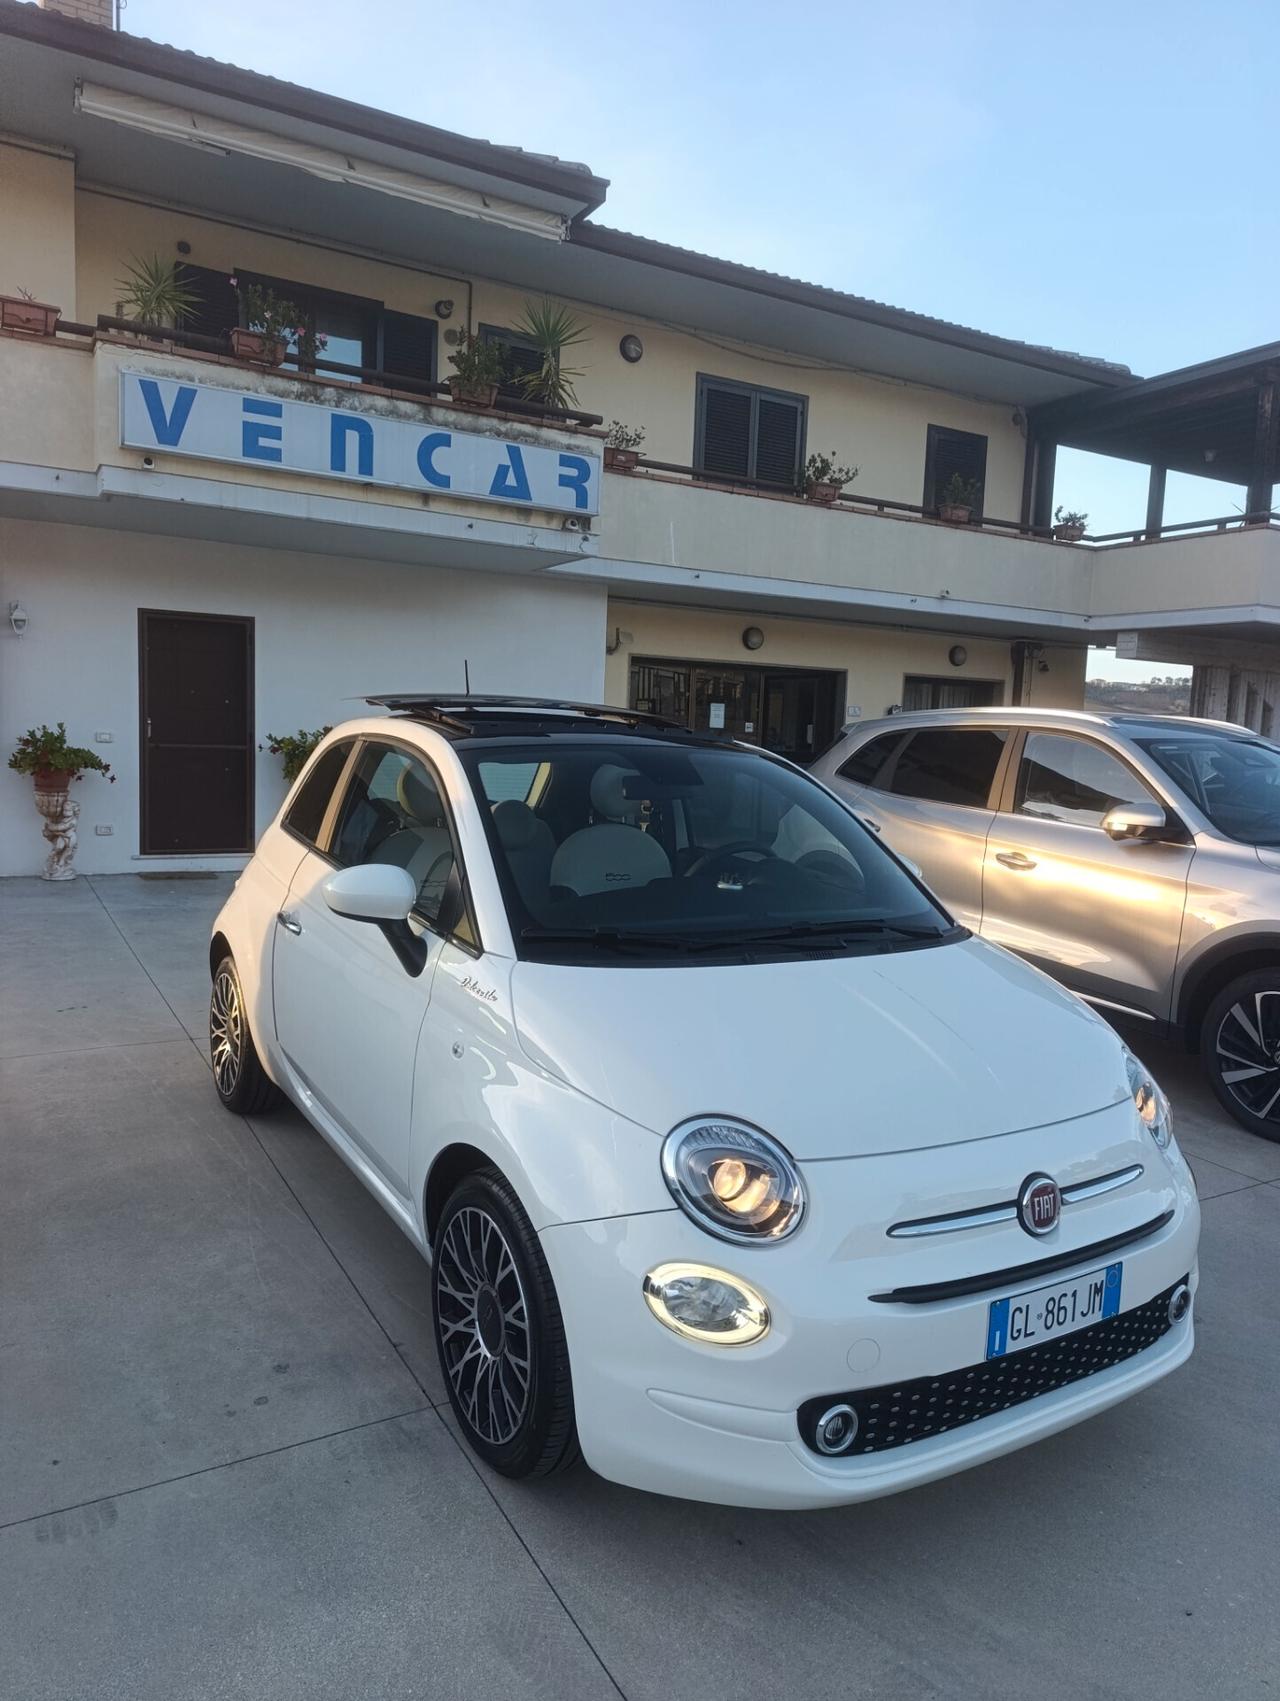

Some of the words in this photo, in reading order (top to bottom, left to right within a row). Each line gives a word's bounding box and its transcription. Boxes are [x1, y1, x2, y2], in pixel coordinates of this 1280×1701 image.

[138, 379, 592, 509] VENCAR
[1034, 1193, 1054, 1220] FIAT
[1010, 1304, 1035, 1341] GL
